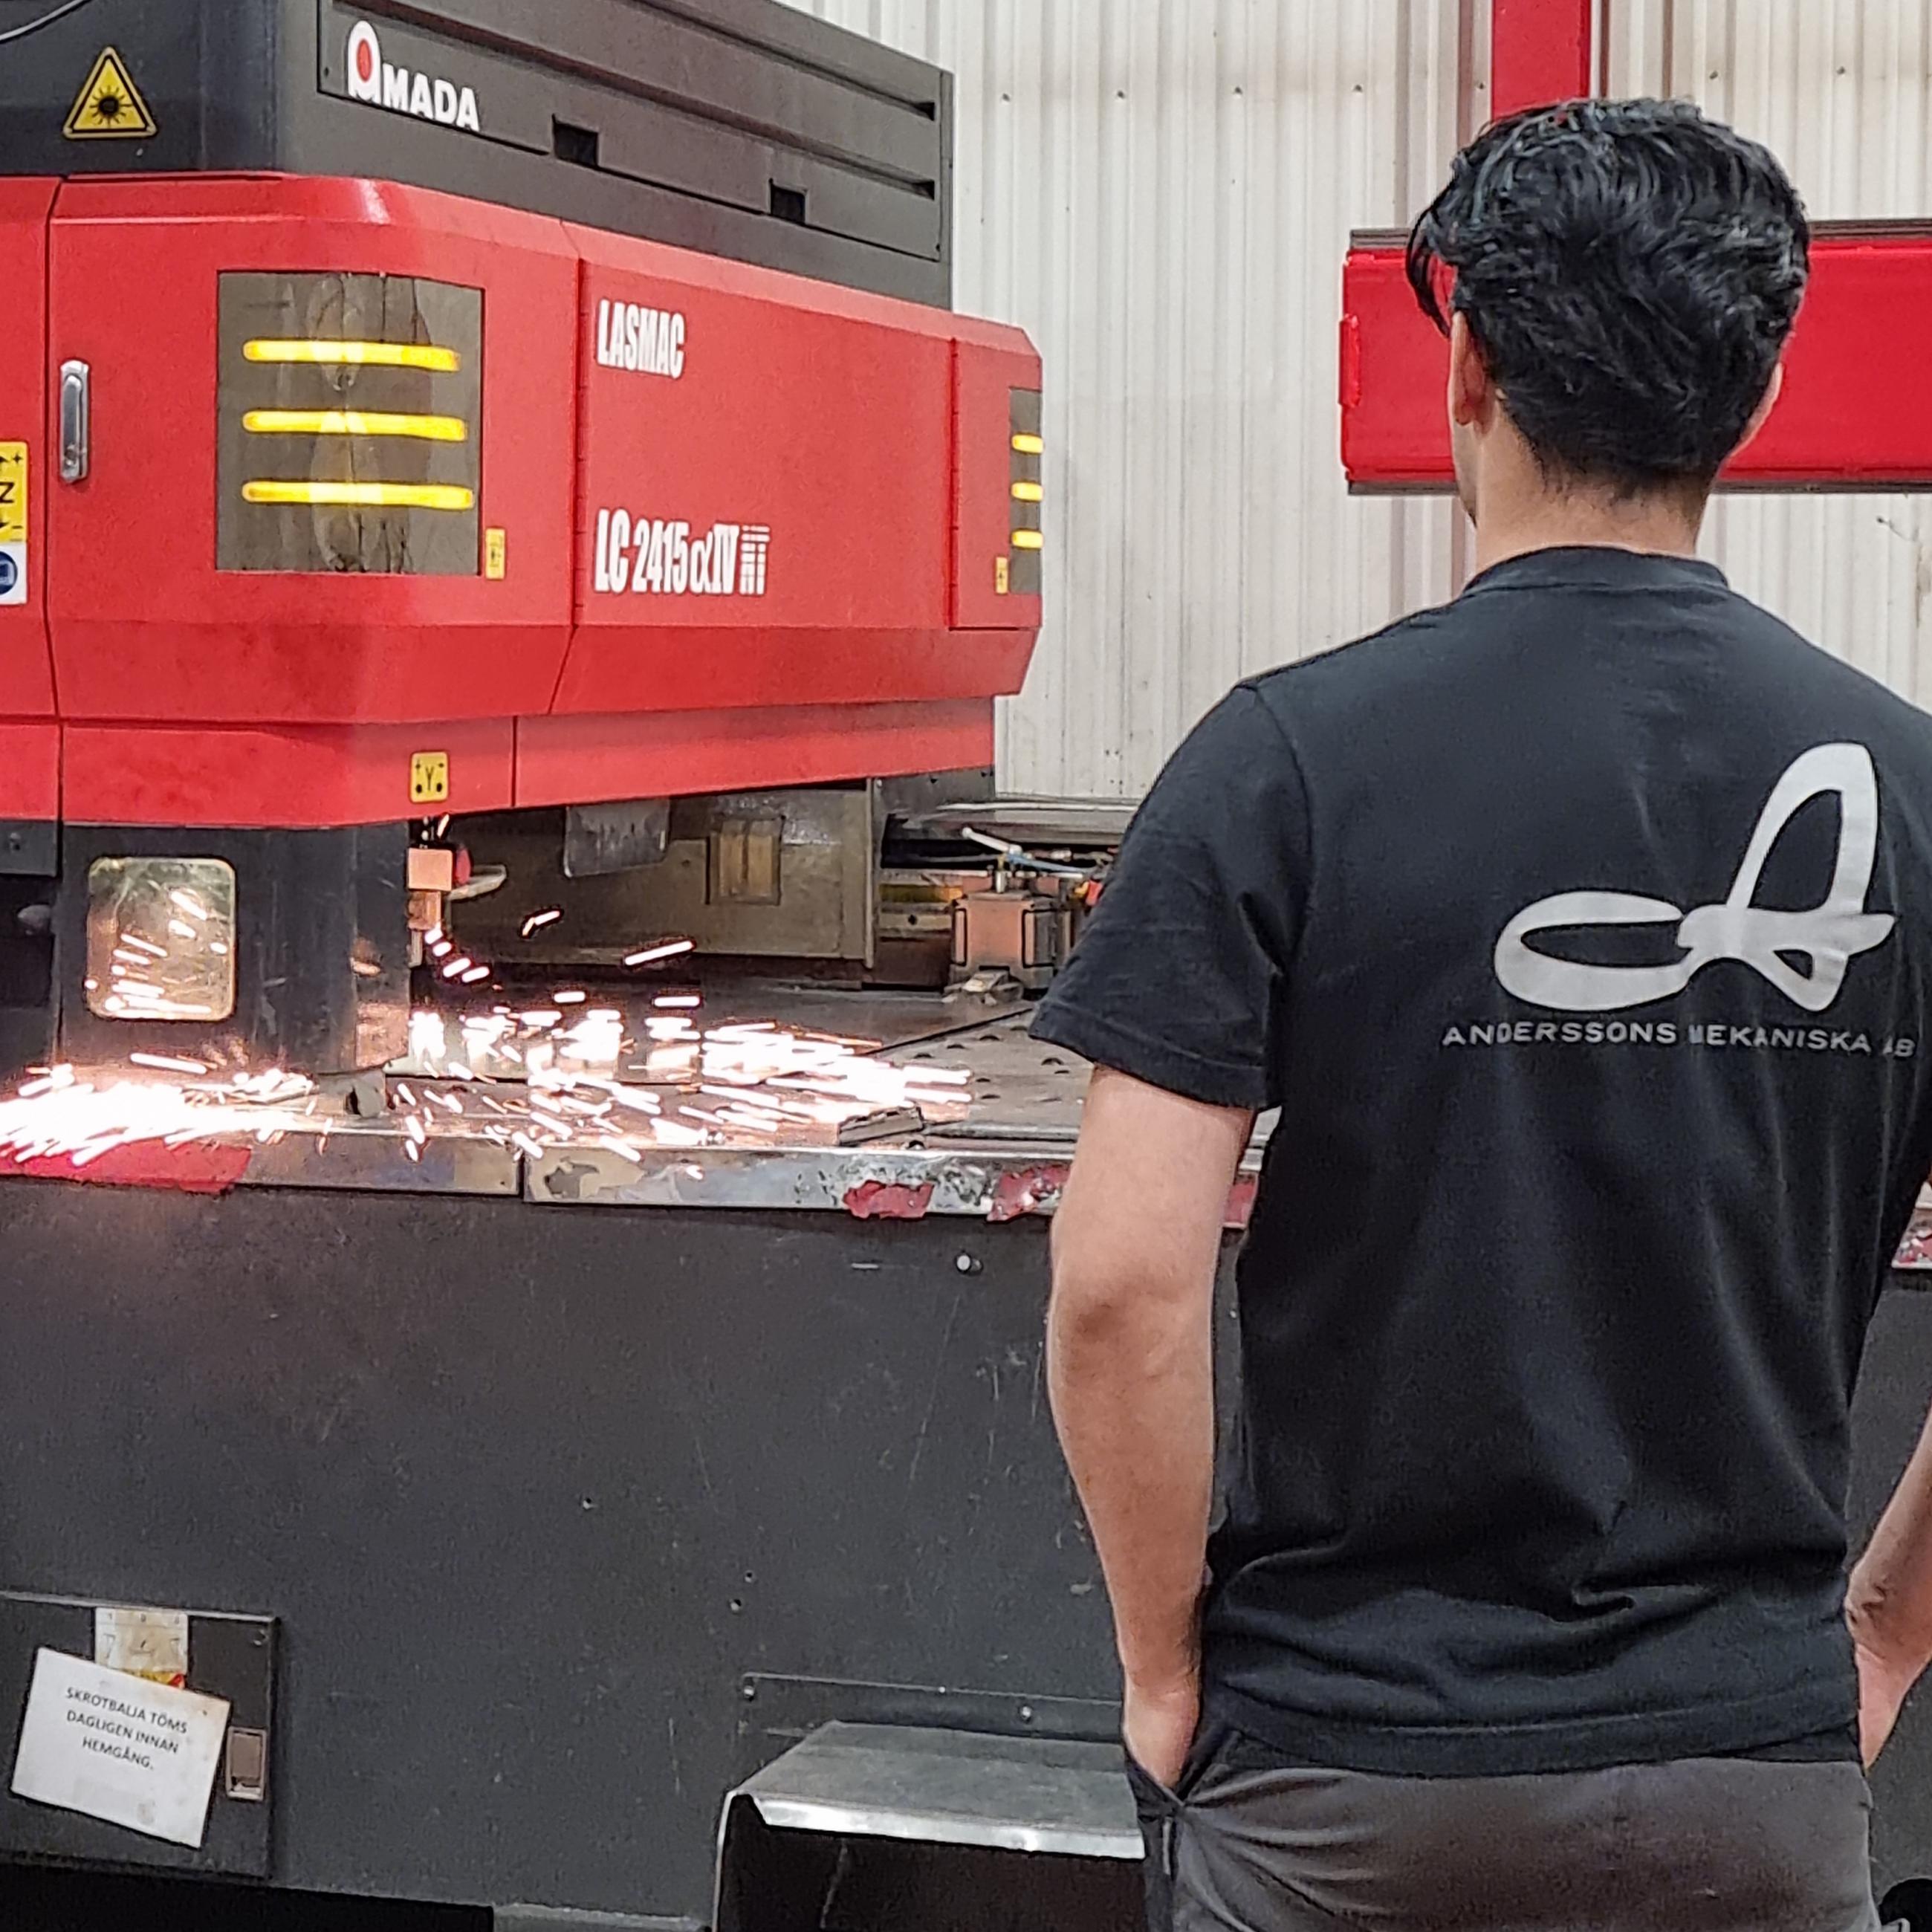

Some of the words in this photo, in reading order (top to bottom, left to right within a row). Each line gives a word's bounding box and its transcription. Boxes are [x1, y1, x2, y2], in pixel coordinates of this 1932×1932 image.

[597, 299, 685, 379] LASMAC
[595, 508, 630, 593] LC
[1442, 1022, 1677, 1046] ANDERSSONS
[66, 1709, 134, 1740] DAGLIGEN
[135, 1730, 179, 1754] INNAN
[150, 1711, 187, 1734] TÖMS
